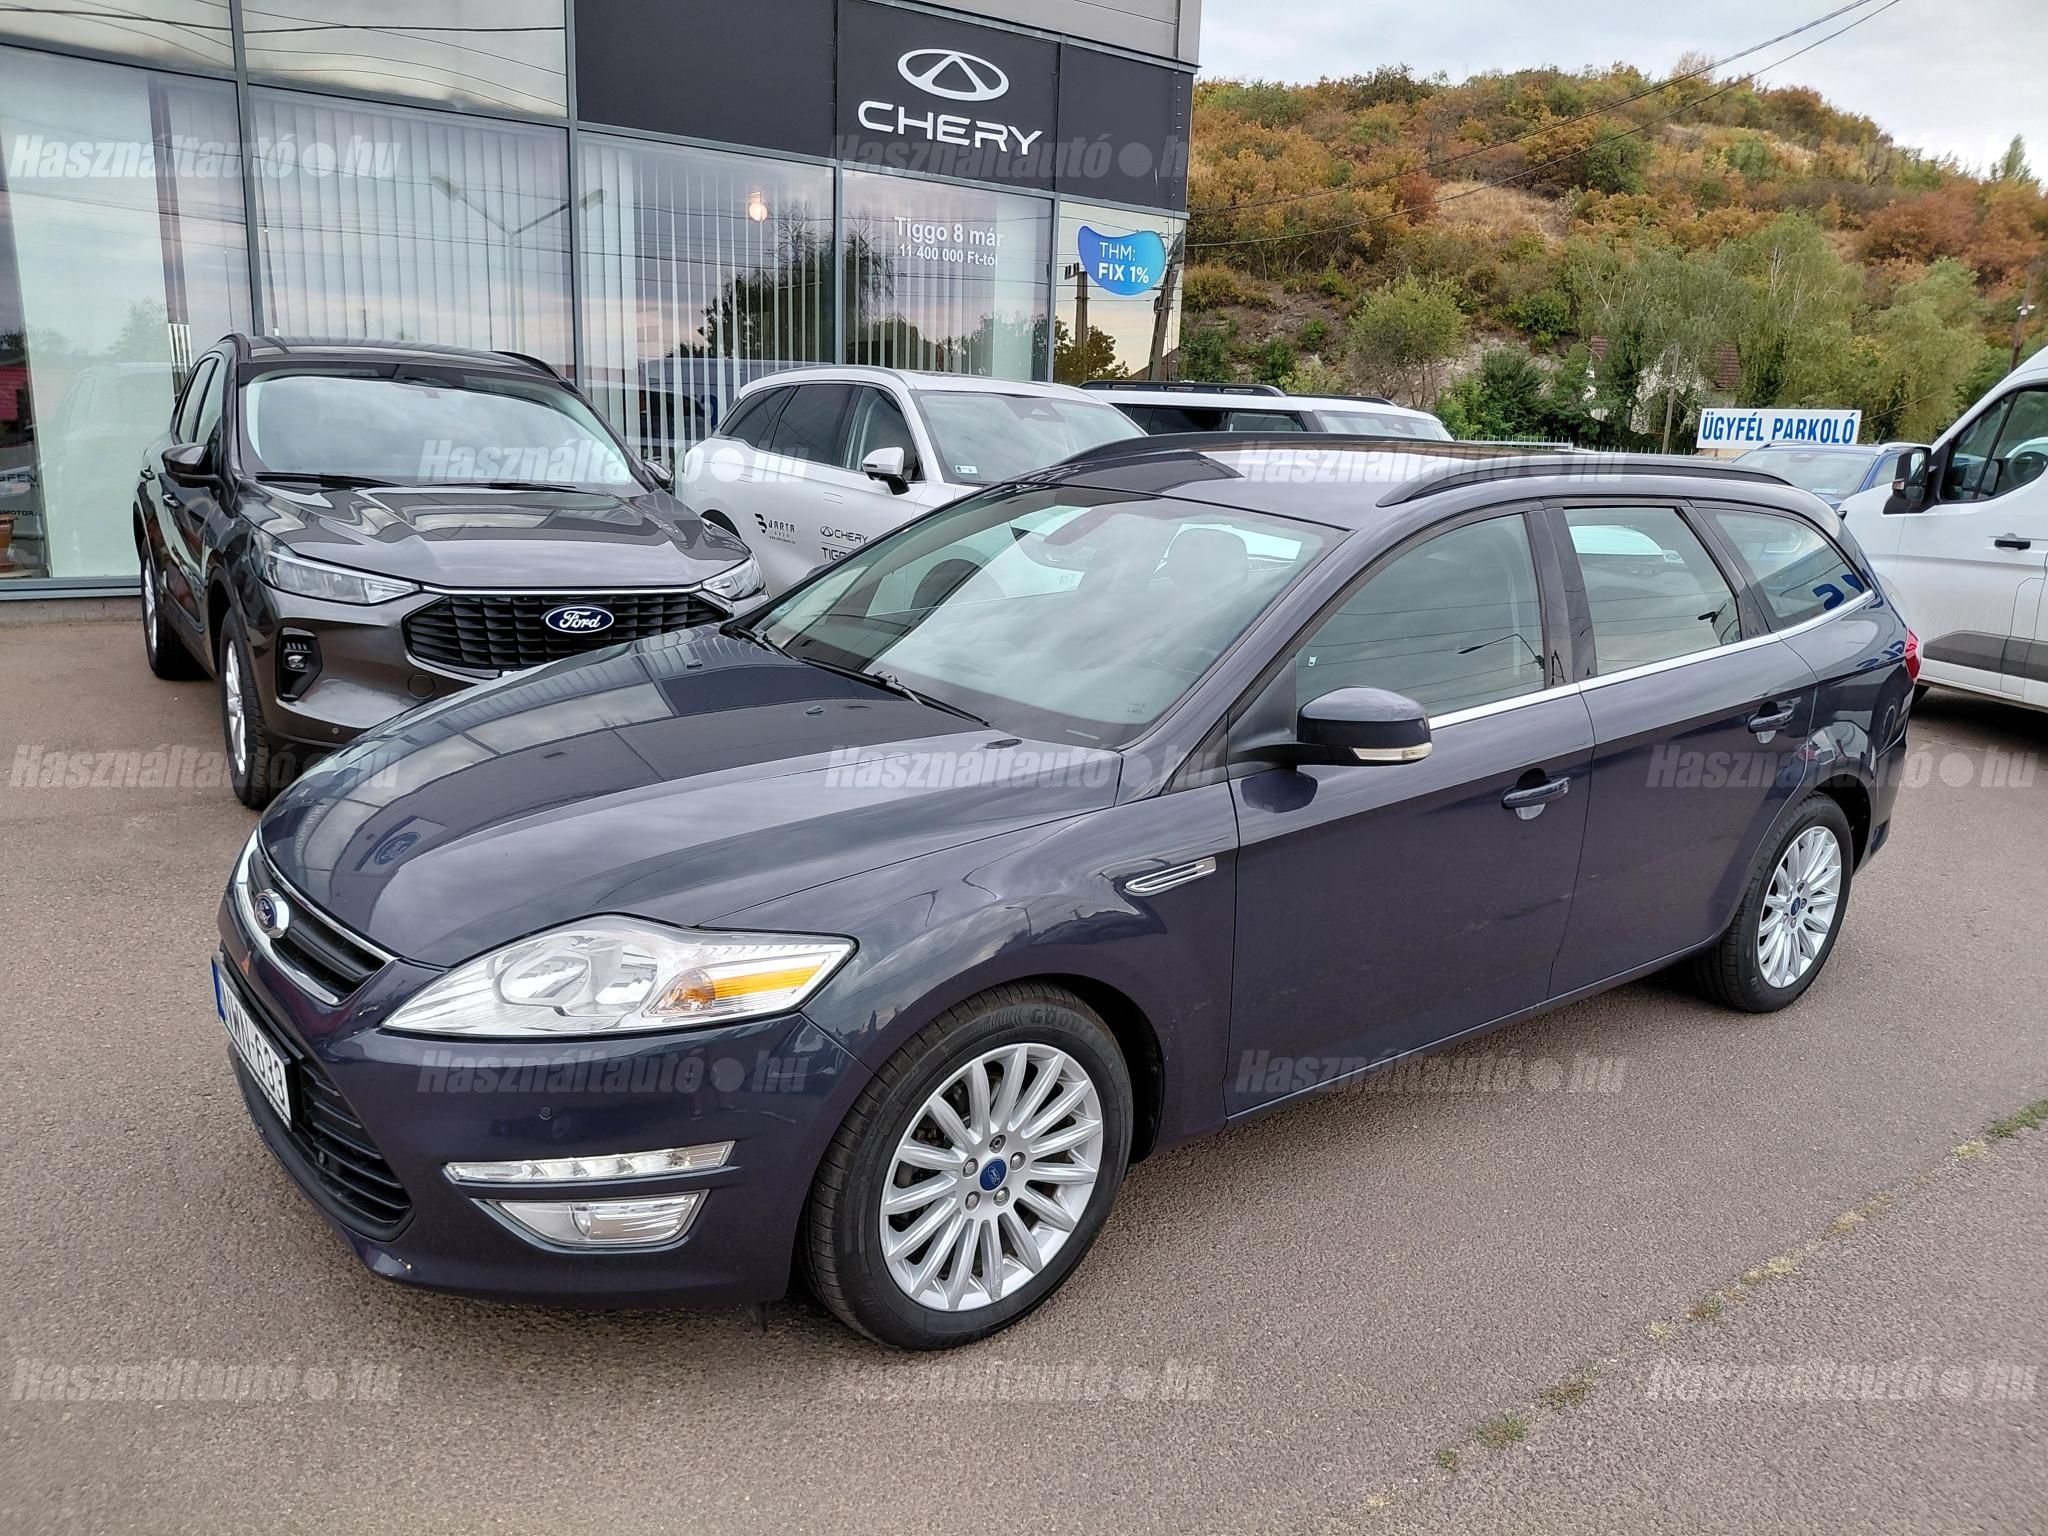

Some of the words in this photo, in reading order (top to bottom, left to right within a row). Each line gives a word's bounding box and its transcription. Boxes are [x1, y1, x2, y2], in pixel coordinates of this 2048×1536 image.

[858, 100, 1043, 155] CHERY
[894, 216, 947, 244] Tiggo
[953, 223, 963, 243] 8
[969, 227, 1004, 247] már
[899, 243, 912, 257] 11
[917, 245, 939, 260] 400
[942, 248, 964, 263] 000
[1099, 241, 1136, 261] THM:
[1098, 262, 1126, 281] FIX
[1130, 265, 1150, 284] 1%
[1702, 411, 1764, 441] ÜGYFÉL
[1771, 412, 1857, 444] PARKOLÓ
[834, 529, 869, 544] CHERY
[559, 610, 602, 629] Ford
